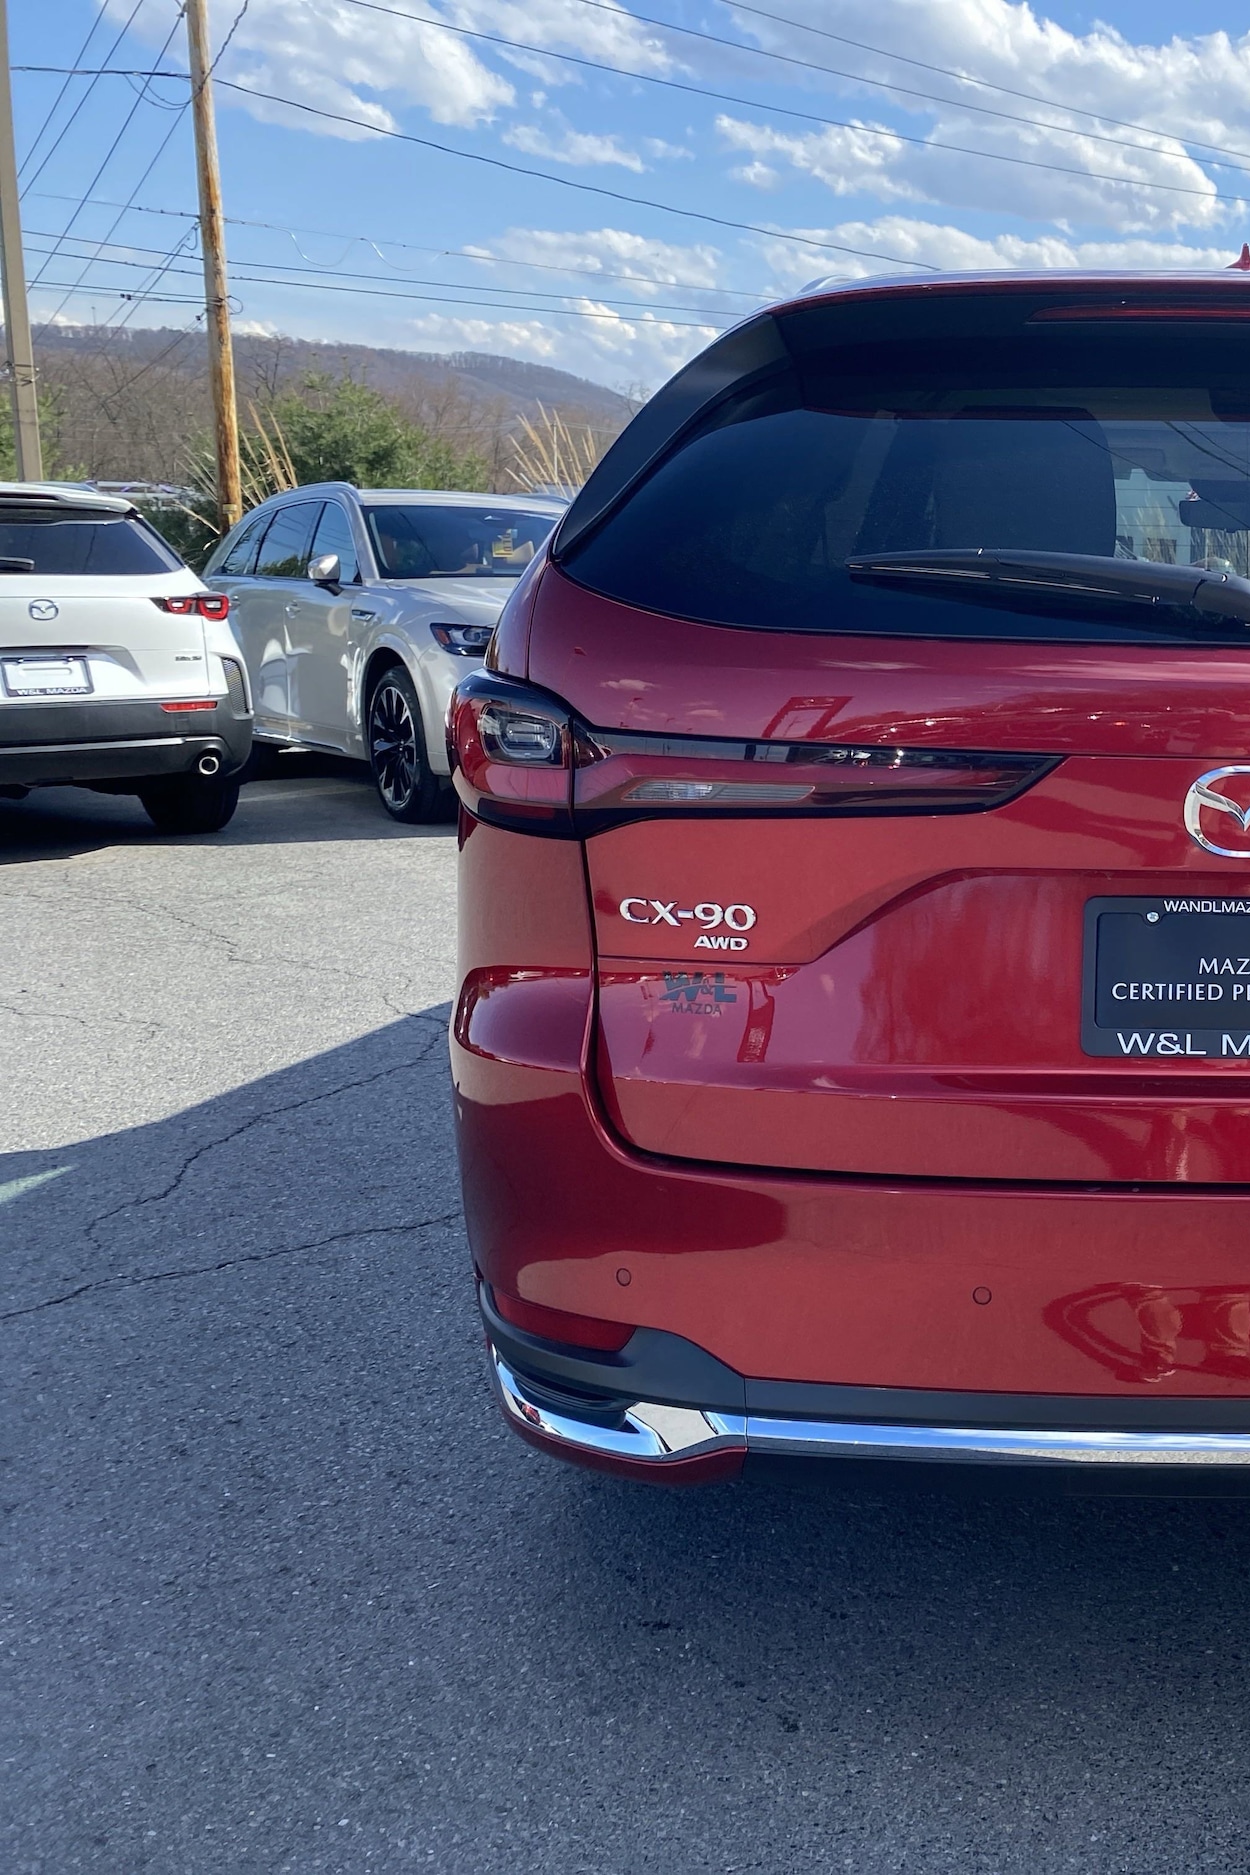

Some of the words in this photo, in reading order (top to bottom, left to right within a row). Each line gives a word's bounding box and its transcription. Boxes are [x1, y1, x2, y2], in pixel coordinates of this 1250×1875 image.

[619, 898, 756, 931] CX-90
[693, 935, 748, 950] AWD
[659, 971, 737, 1003] W&L
[1111, 983, 1223, 1001] CERTIFIED
[672, 1003, 722, 1015] MAZDA
[1117, 1033, 1207, 1055] W&L
